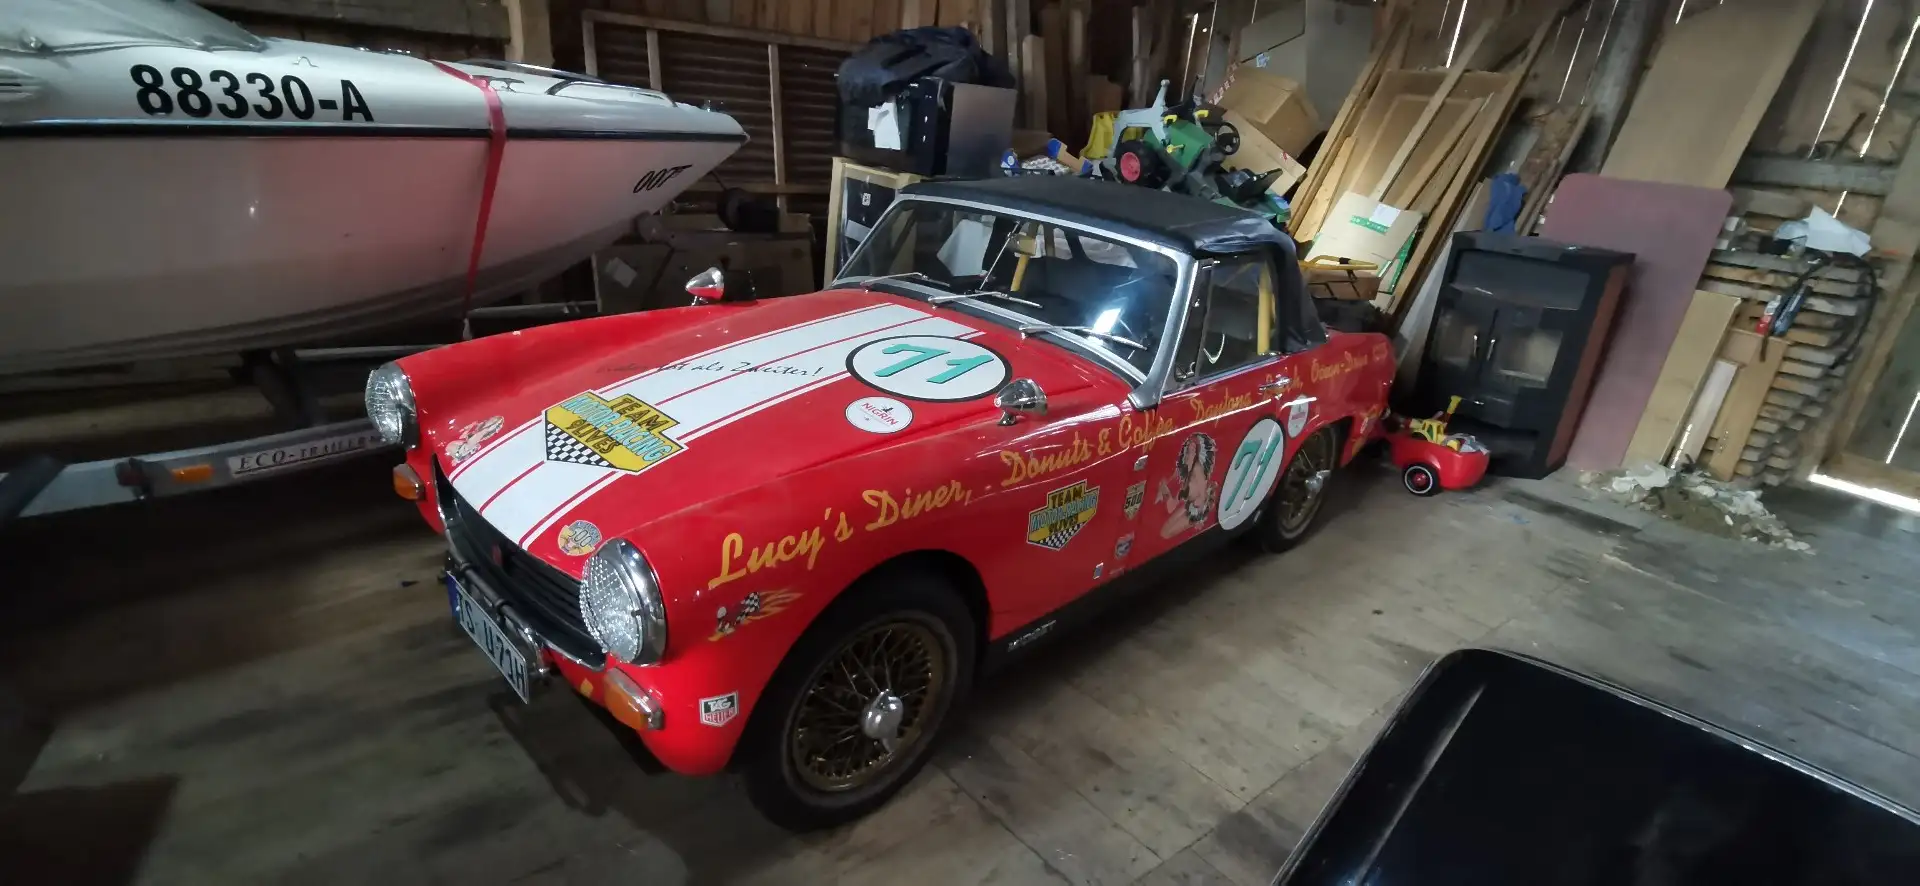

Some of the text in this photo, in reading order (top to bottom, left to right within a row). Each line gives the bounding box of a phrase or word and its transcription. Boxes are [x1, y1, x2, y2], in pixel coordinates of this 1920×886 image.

[130, 64, 374, 122] 88330-A
[633, 164, 693, 193] 007
[691, 361, 724, 372] als
[730, 361, 823, 377] Zweiter!
[874, 343, 994, 384] 71
[560, 395, 672, 462] MOTOR-RACING
[611, 397, 669, 431] TEAM
[861, 402, 899, 426] NIGRIN
[565, 419, 618, 454] 9LIVES
[1224, 433, 1280, 511] 71
[708, 506, 853, 591] Lucy's
[862, 480, 972, 531] Diner,
[1000, 431, 1092, 487] Donuts
[1098, 428, 1112, 455] &
[1118, 408, 1173, 452] Coffee
[1050, 485, 1086, 509] TEAM
[1124, 492, 1143, 510] 500
[705, 707, 735, 723] HEUER
[708, 697, 732, 712] TAG
